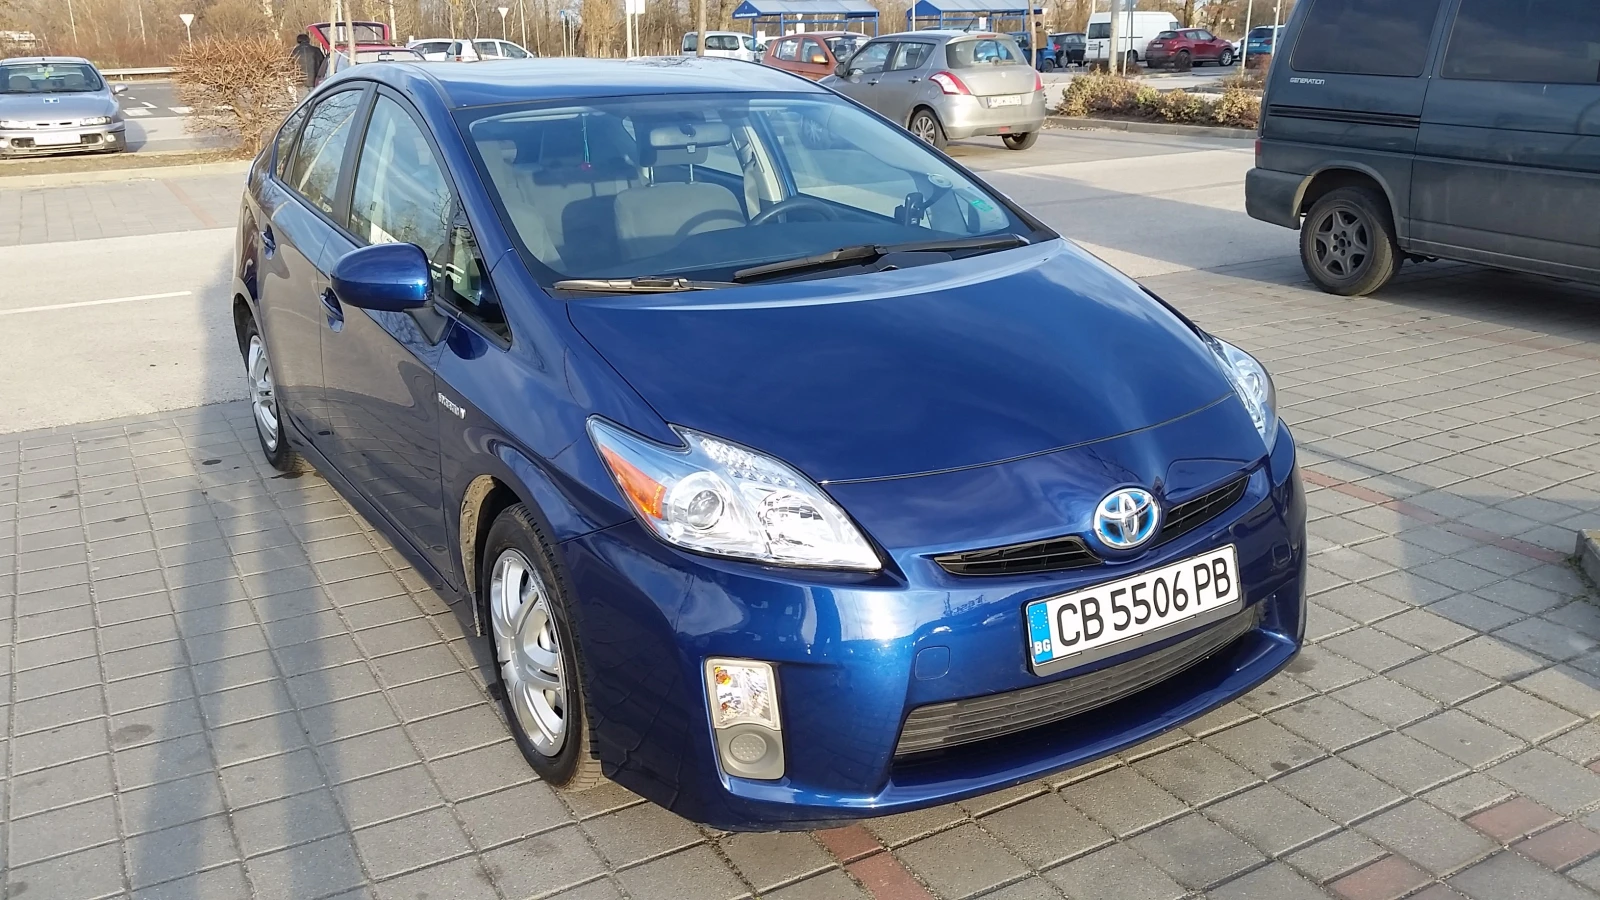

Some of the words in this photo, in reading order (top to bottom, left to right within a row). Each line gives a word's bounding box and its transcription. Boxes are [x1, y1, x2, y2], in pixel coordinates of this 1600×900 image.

[1056, 596, 1105, 647] CB
[1110, 570, 1189, 632] 5506
[1193, 557, 1232, 606] PB
[1033, 638, 1052, 655] BG
